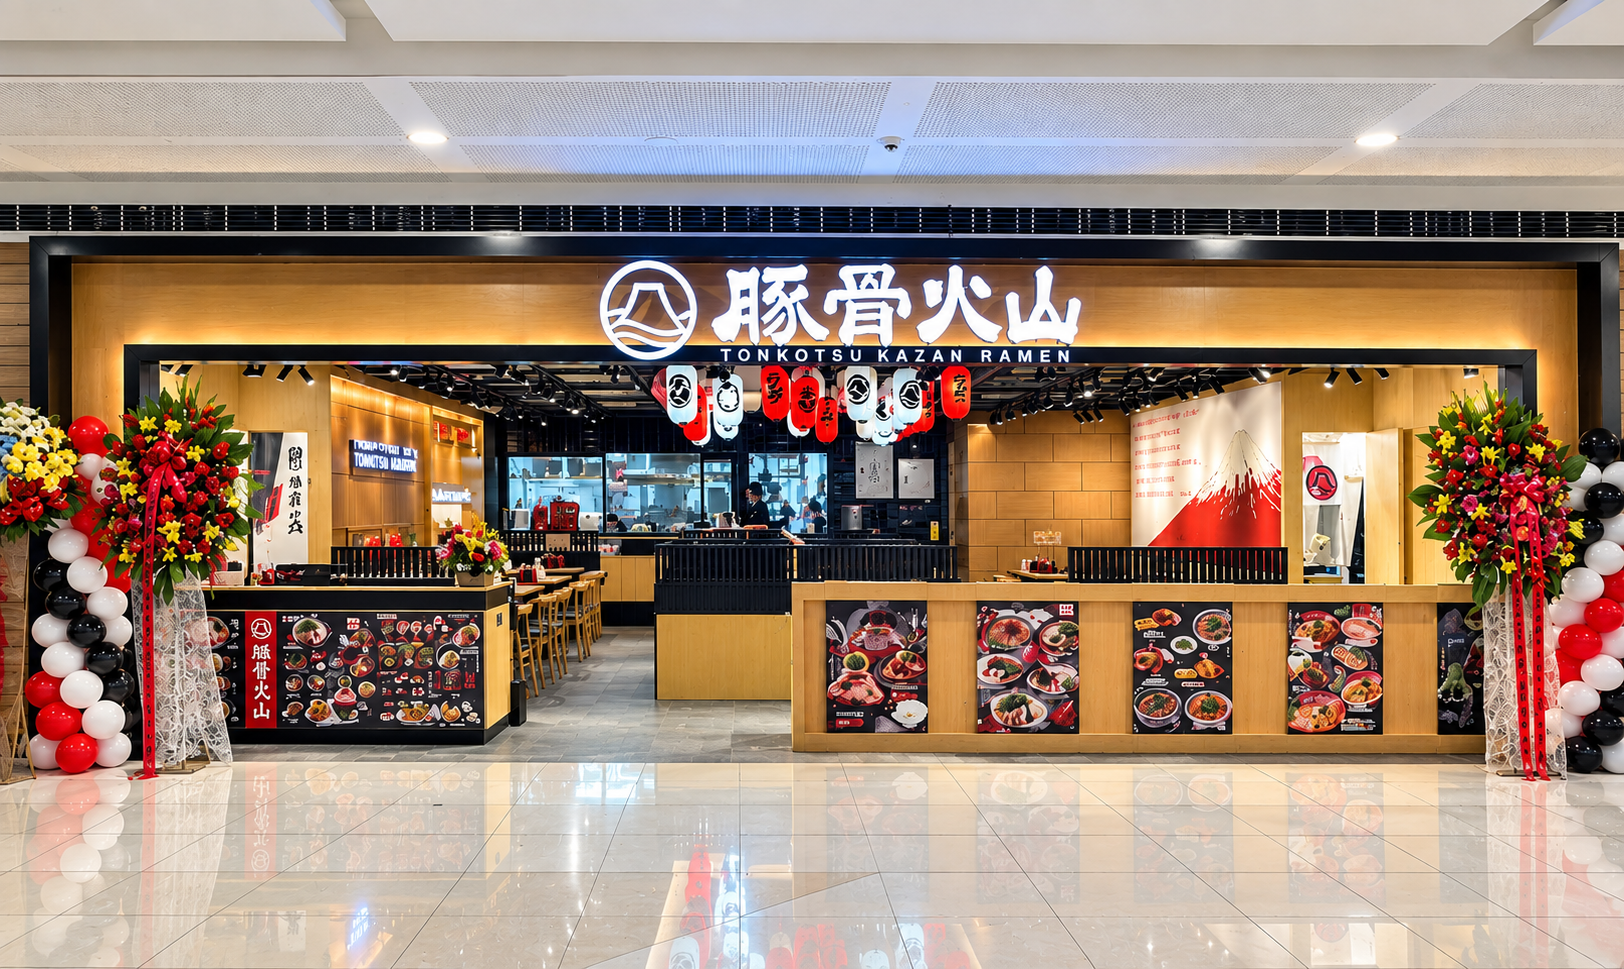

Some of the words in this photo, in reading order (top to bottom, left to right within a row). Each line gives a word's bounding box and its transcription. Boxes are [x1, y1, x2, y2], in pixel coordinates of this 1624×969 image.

[711, 264, 1081, 346] 豚骨火山
[720, 348, 862, 363] TONKOTSU
[878, 348, 962, 363] KAZAN
[981, 349, 1070, 363] RAMEN
